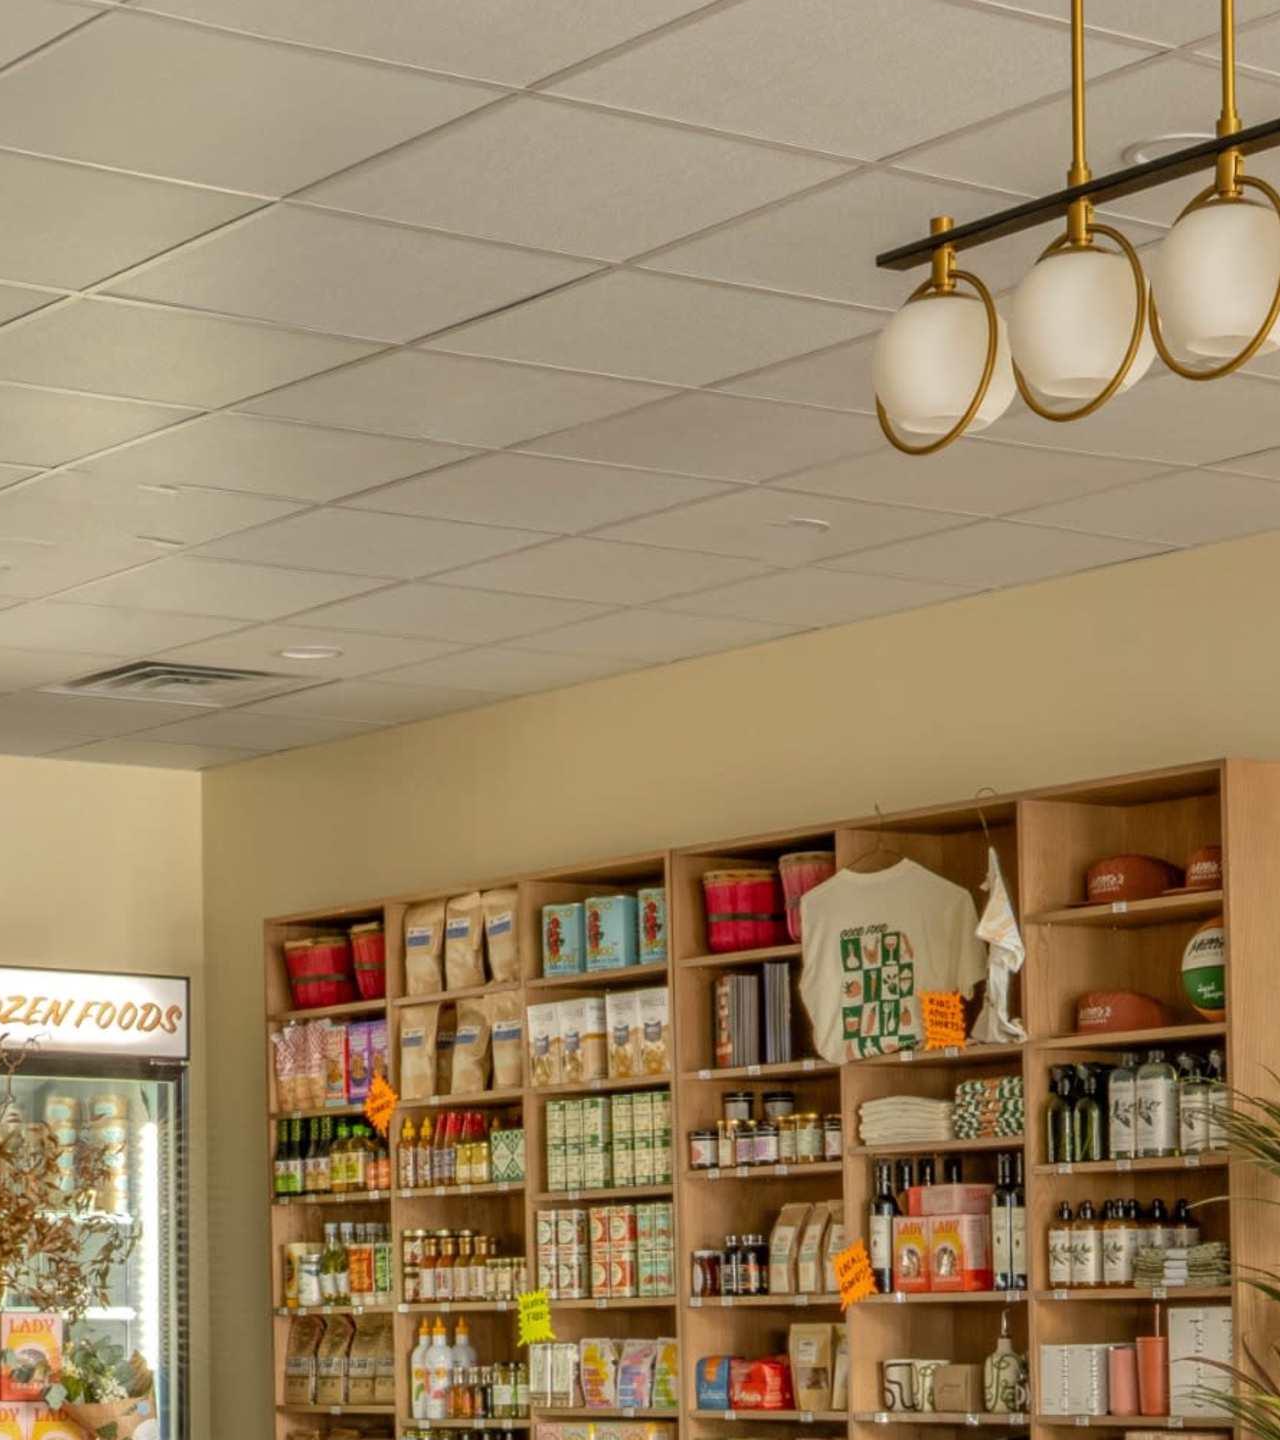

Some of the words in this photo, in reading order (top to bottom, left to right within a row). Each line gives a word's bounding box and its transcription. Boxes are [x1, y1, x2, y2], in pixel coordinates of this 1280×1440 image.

[75, 1002, 183, 1036] FOODS
[9, 1318, 54, 1335] LADY
[35, 1408, 69, 1422] LAD
